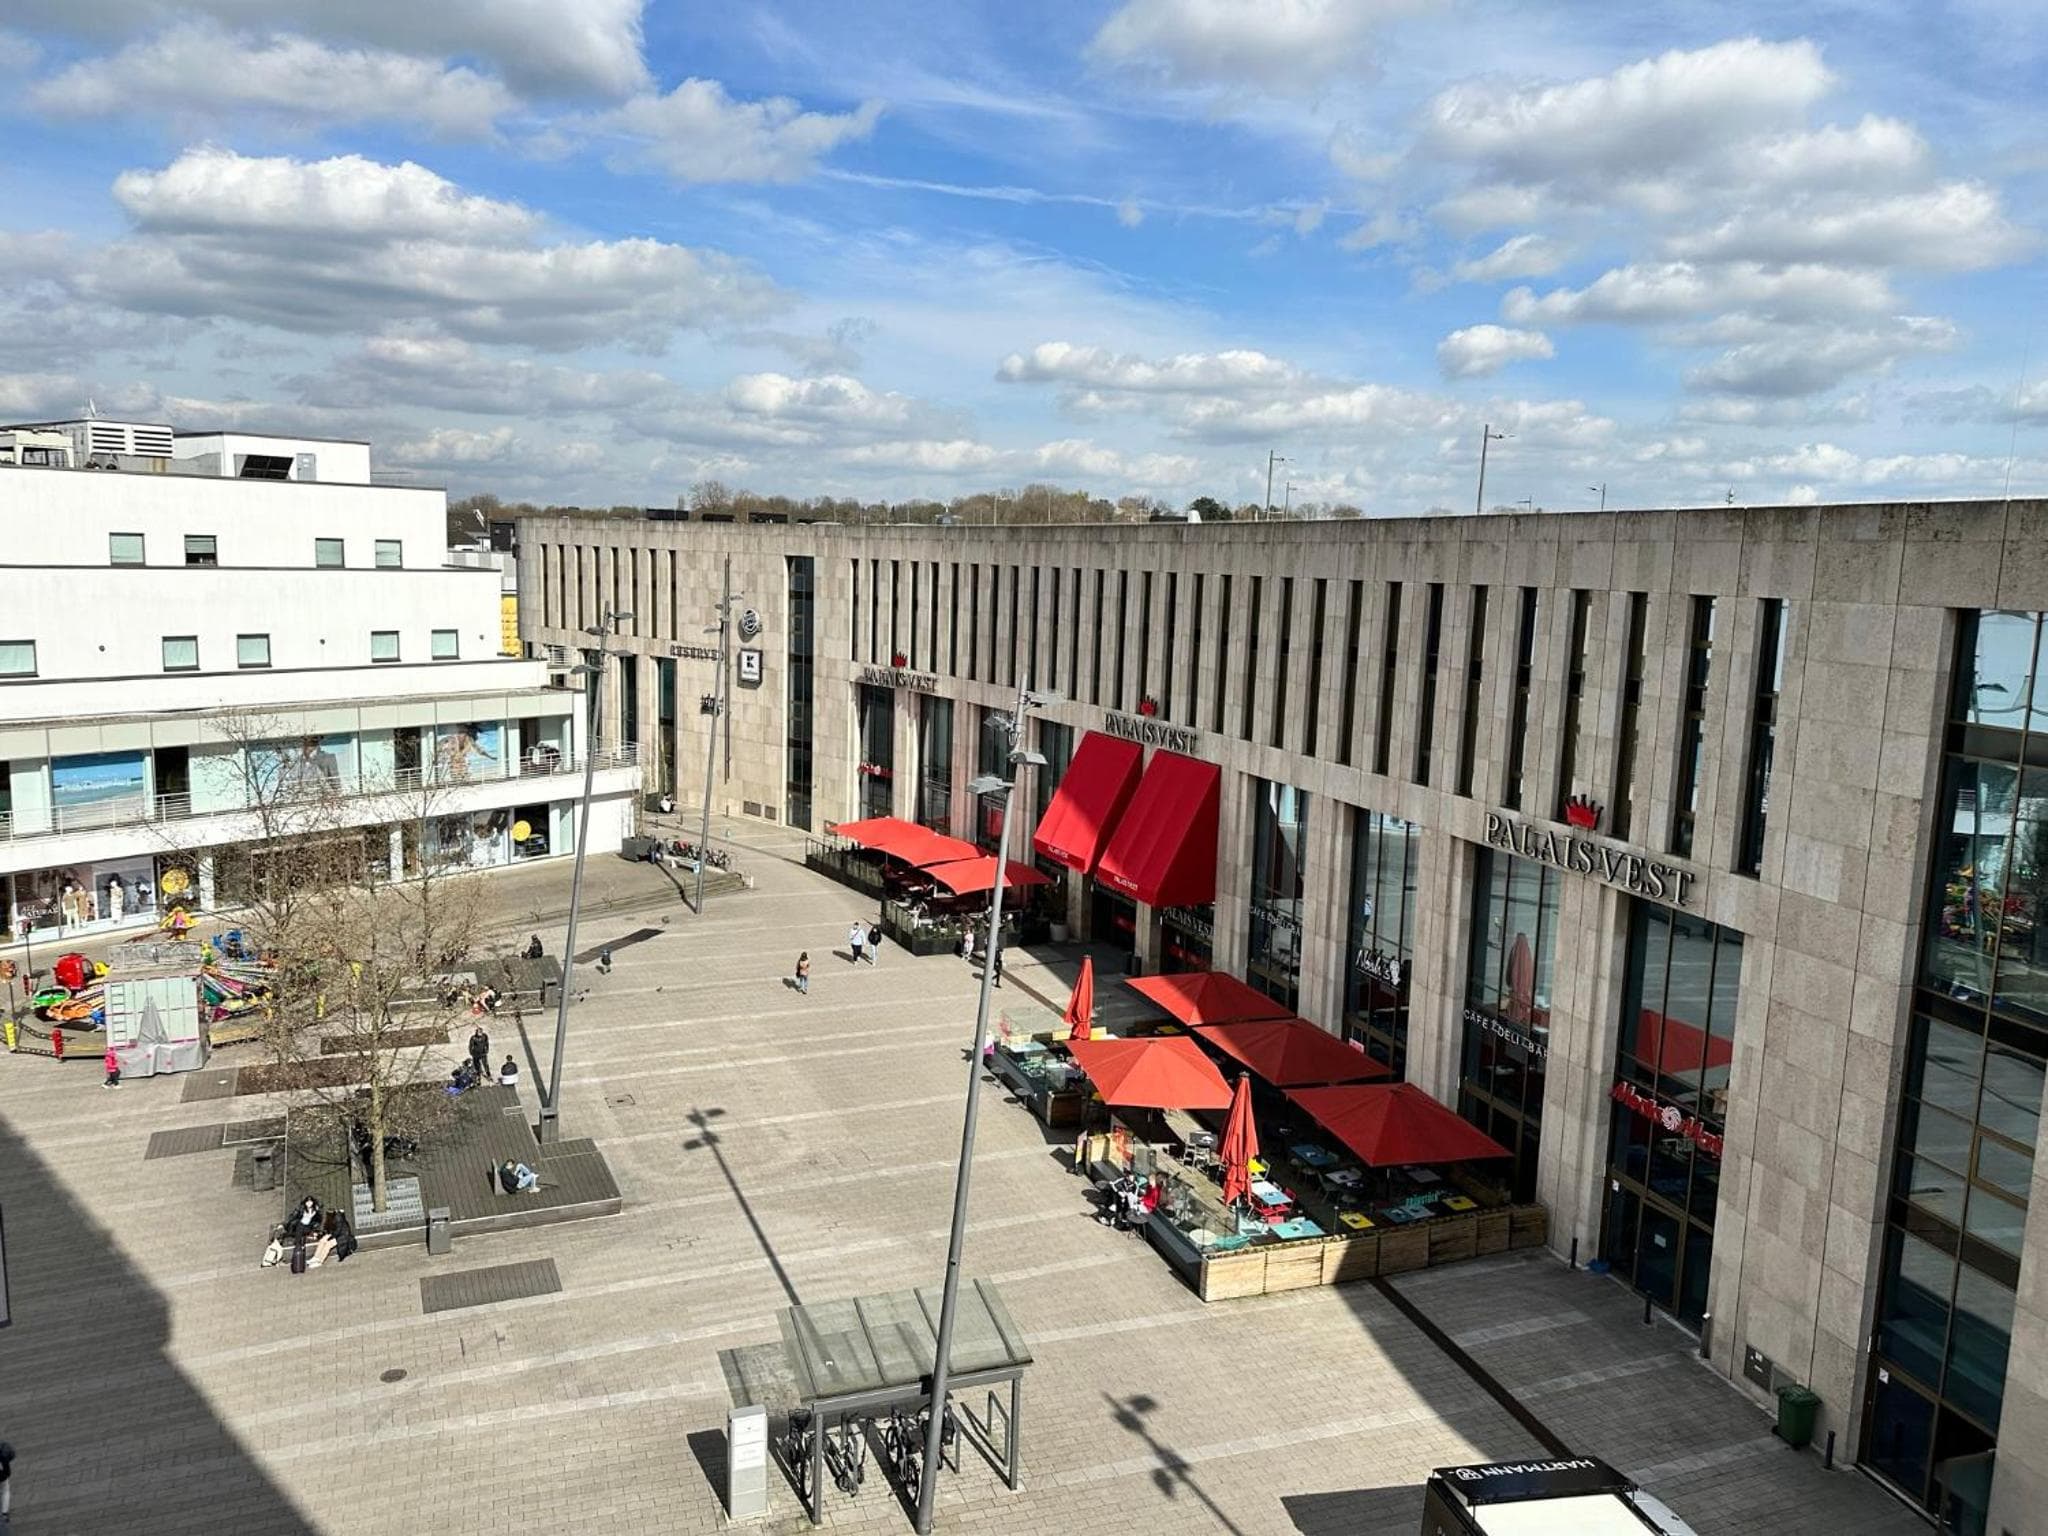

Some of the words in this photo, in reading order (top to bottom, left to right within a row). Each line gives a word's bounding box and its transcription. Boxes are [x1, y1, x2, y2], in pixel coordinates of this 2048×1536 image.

[1485, 812, 1594, 875] PALAIS
[1599, 847, 1695, 906] VEST
[1463, 1009, 1489, 1030] CAFE
[1497, 1025, 1520, 1045] DELI
[1480, 1458, 1597, 1477] HARTMANN
